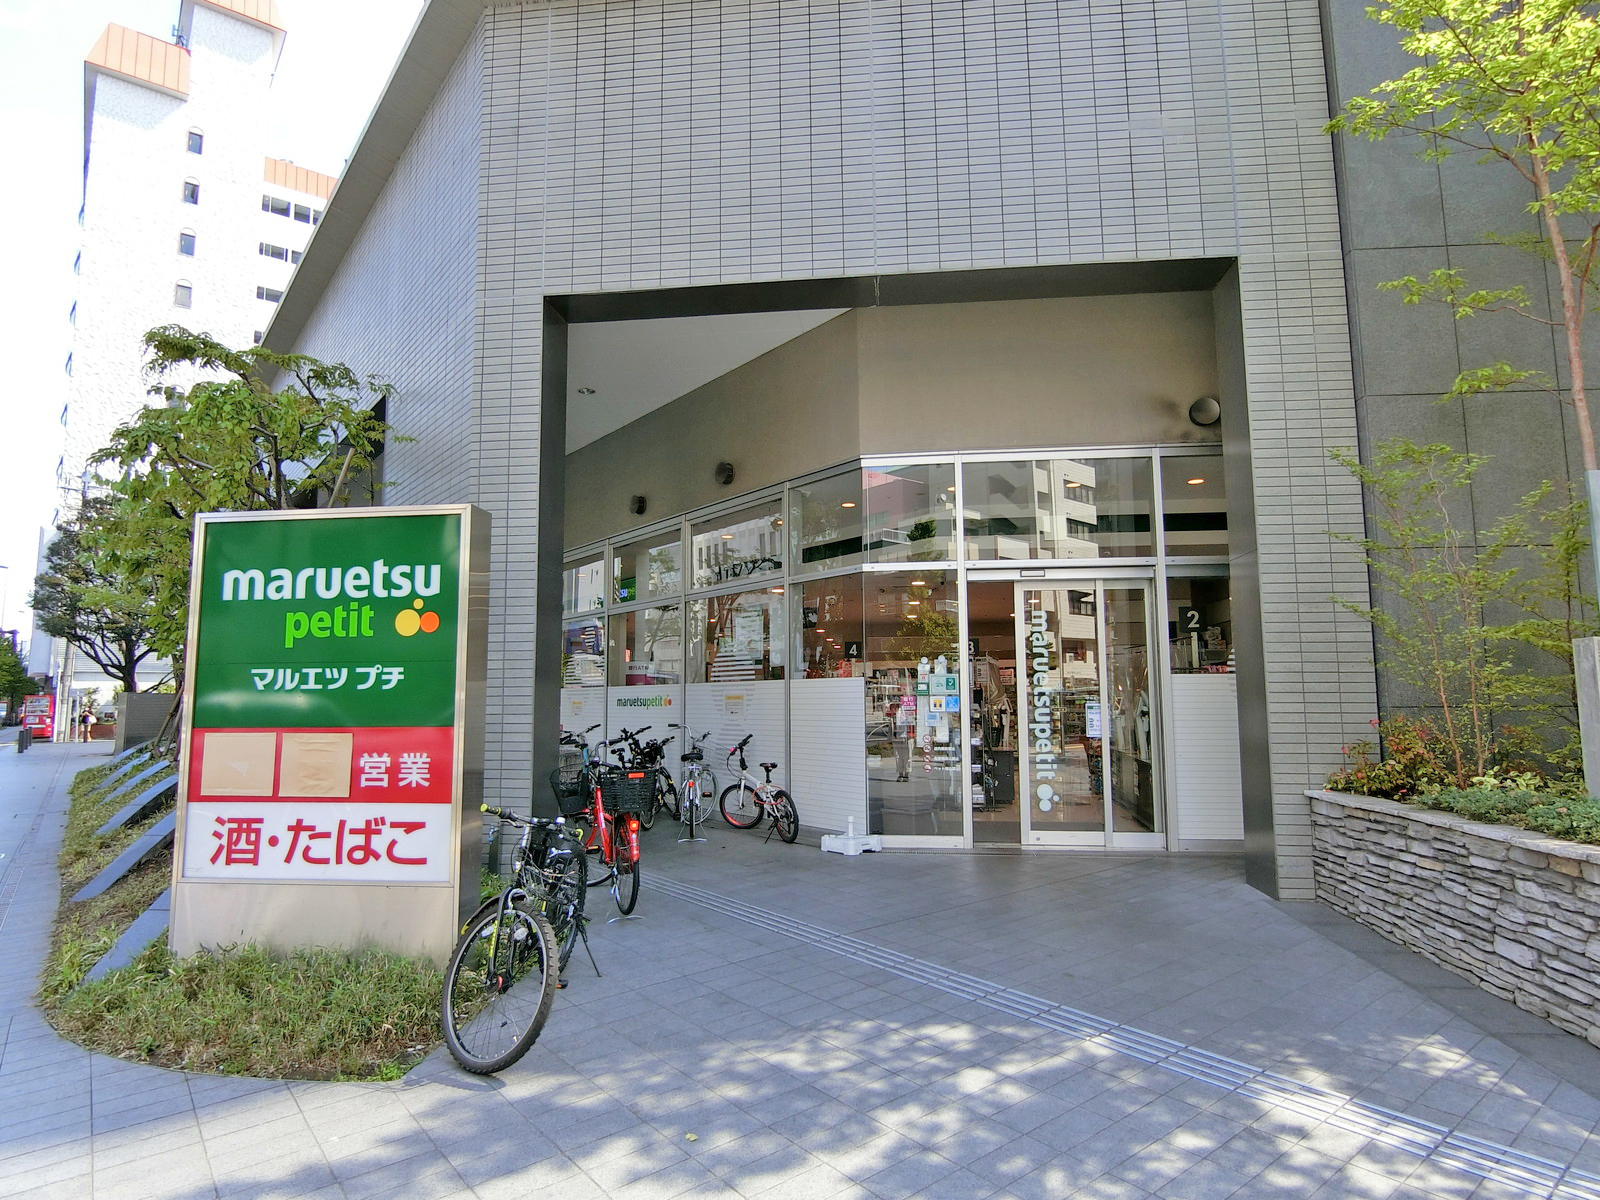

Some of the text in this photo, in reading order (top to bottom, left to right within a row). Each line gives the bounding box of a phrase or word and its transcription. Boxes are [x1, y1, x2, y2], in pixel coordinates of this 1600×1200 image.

[221, 558, 441, 601] maruetsu
[284, 601, 375, 649] petit
[1186, 610, 1200, 628] 2
[849, 644, 858, 656] 4
[968, 641, 975, 653] 3
[250, 663, 405, 691] マルエツ プチ
[1028, 610, 1058, 780] maruetsupetit
[359, 752, 431, 788] 営業
[209, 815, 428, 867] 酒・たばこ
